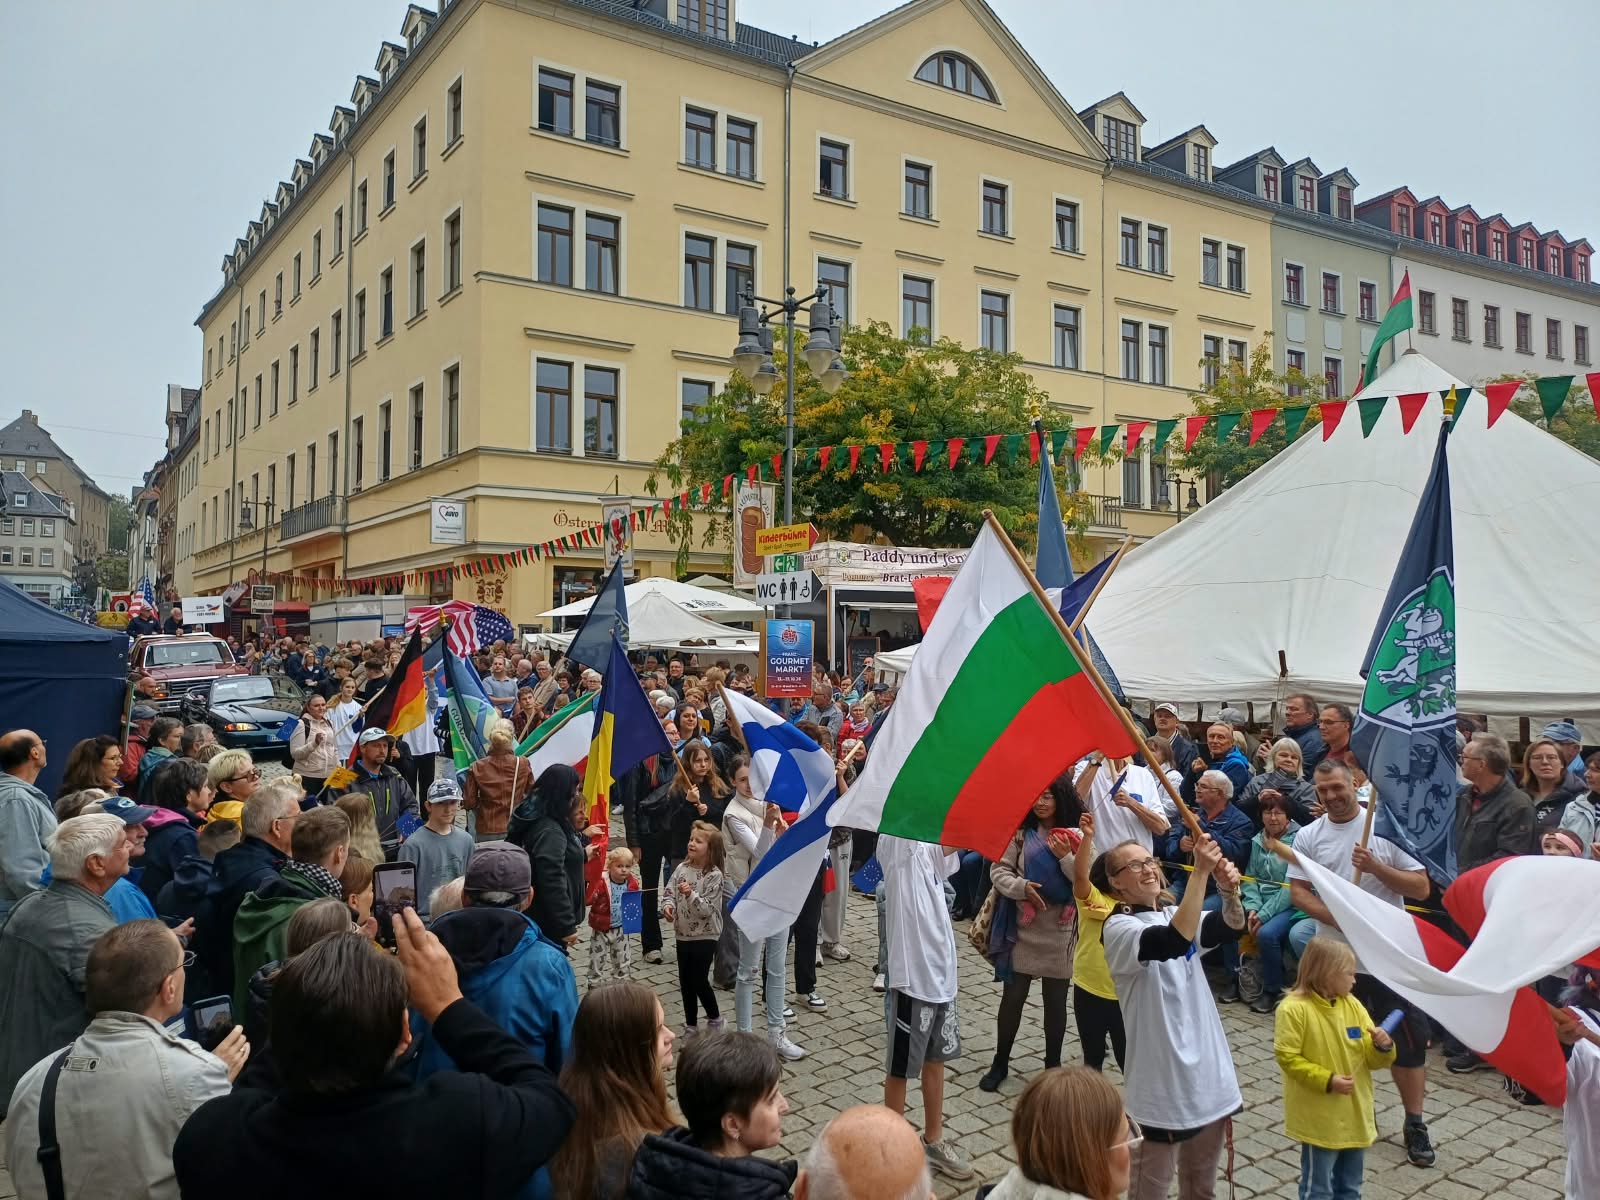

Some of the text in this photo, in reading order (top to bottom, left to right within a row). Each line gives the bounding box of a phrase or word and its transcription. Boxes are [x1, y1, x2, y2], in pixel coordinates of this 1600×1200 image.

[758, 530, 807, 544] Kinderbühne
[864, 550, 905, 566] Paddy
[911, 550, 938, 563] und
[757, 583, 777, 598] WC
[770, 657, 810, 665] GOURMET
[775, 665, 804, 673] MARKT
